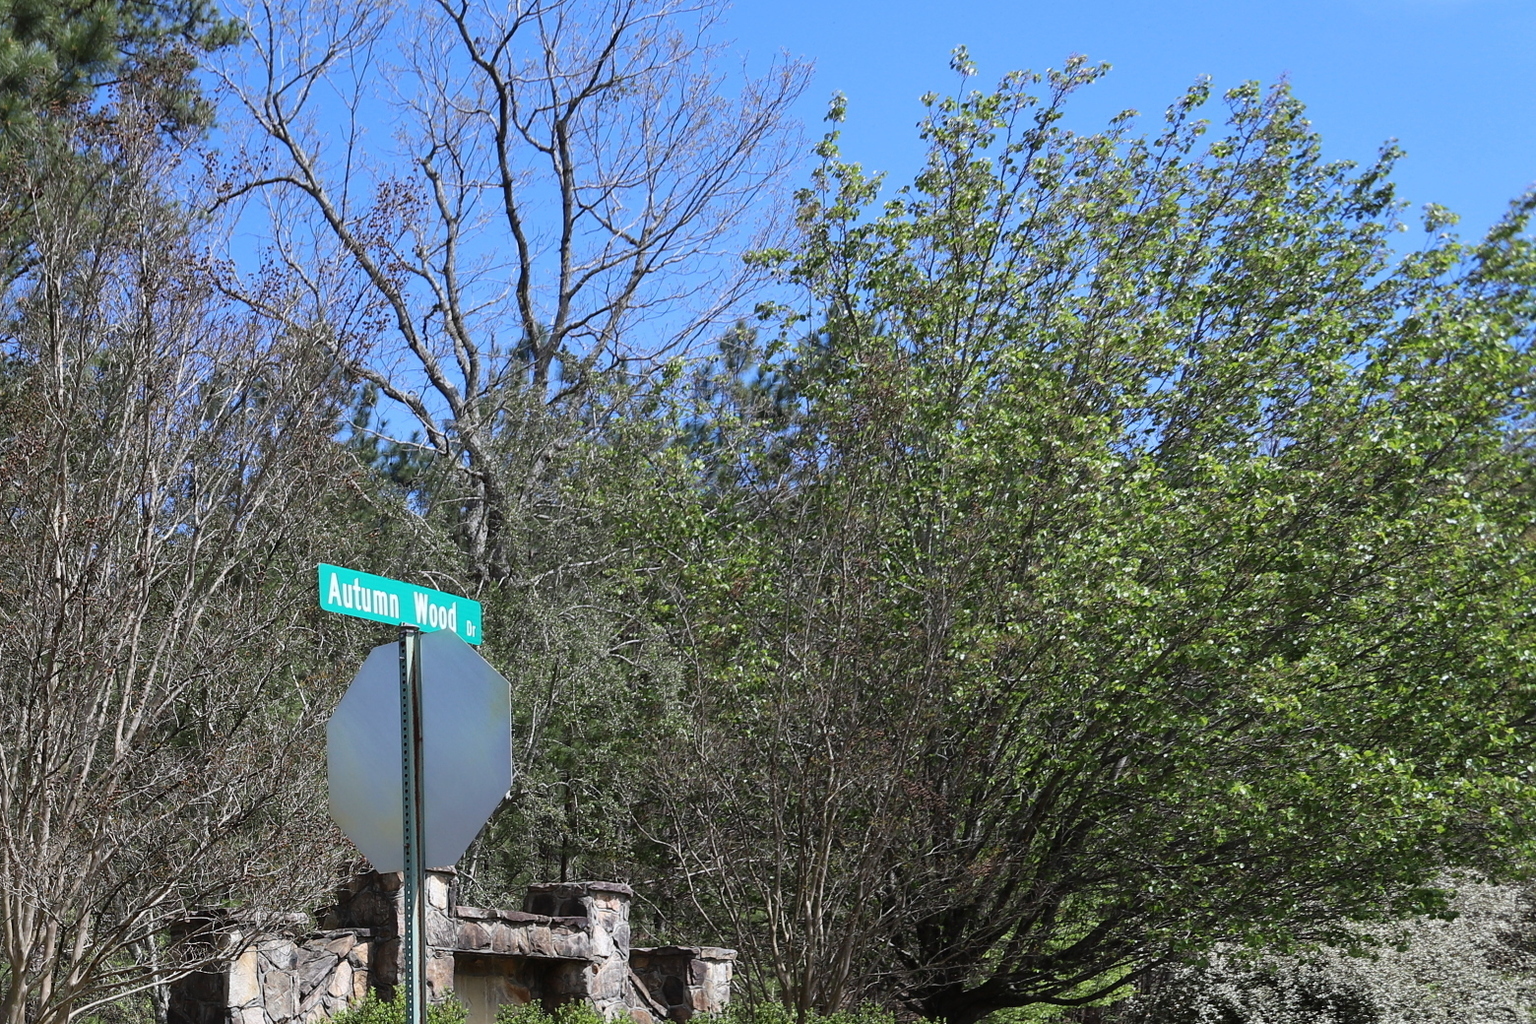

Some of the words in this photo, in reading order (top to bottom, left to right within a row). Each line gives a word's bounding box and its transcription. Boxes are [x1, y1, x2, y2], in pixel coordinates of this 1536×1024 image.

[328, 572, 400, 619] Autumn
[413, 591, 457, 633] Wood
[466, 620, 477, 638] Dr
